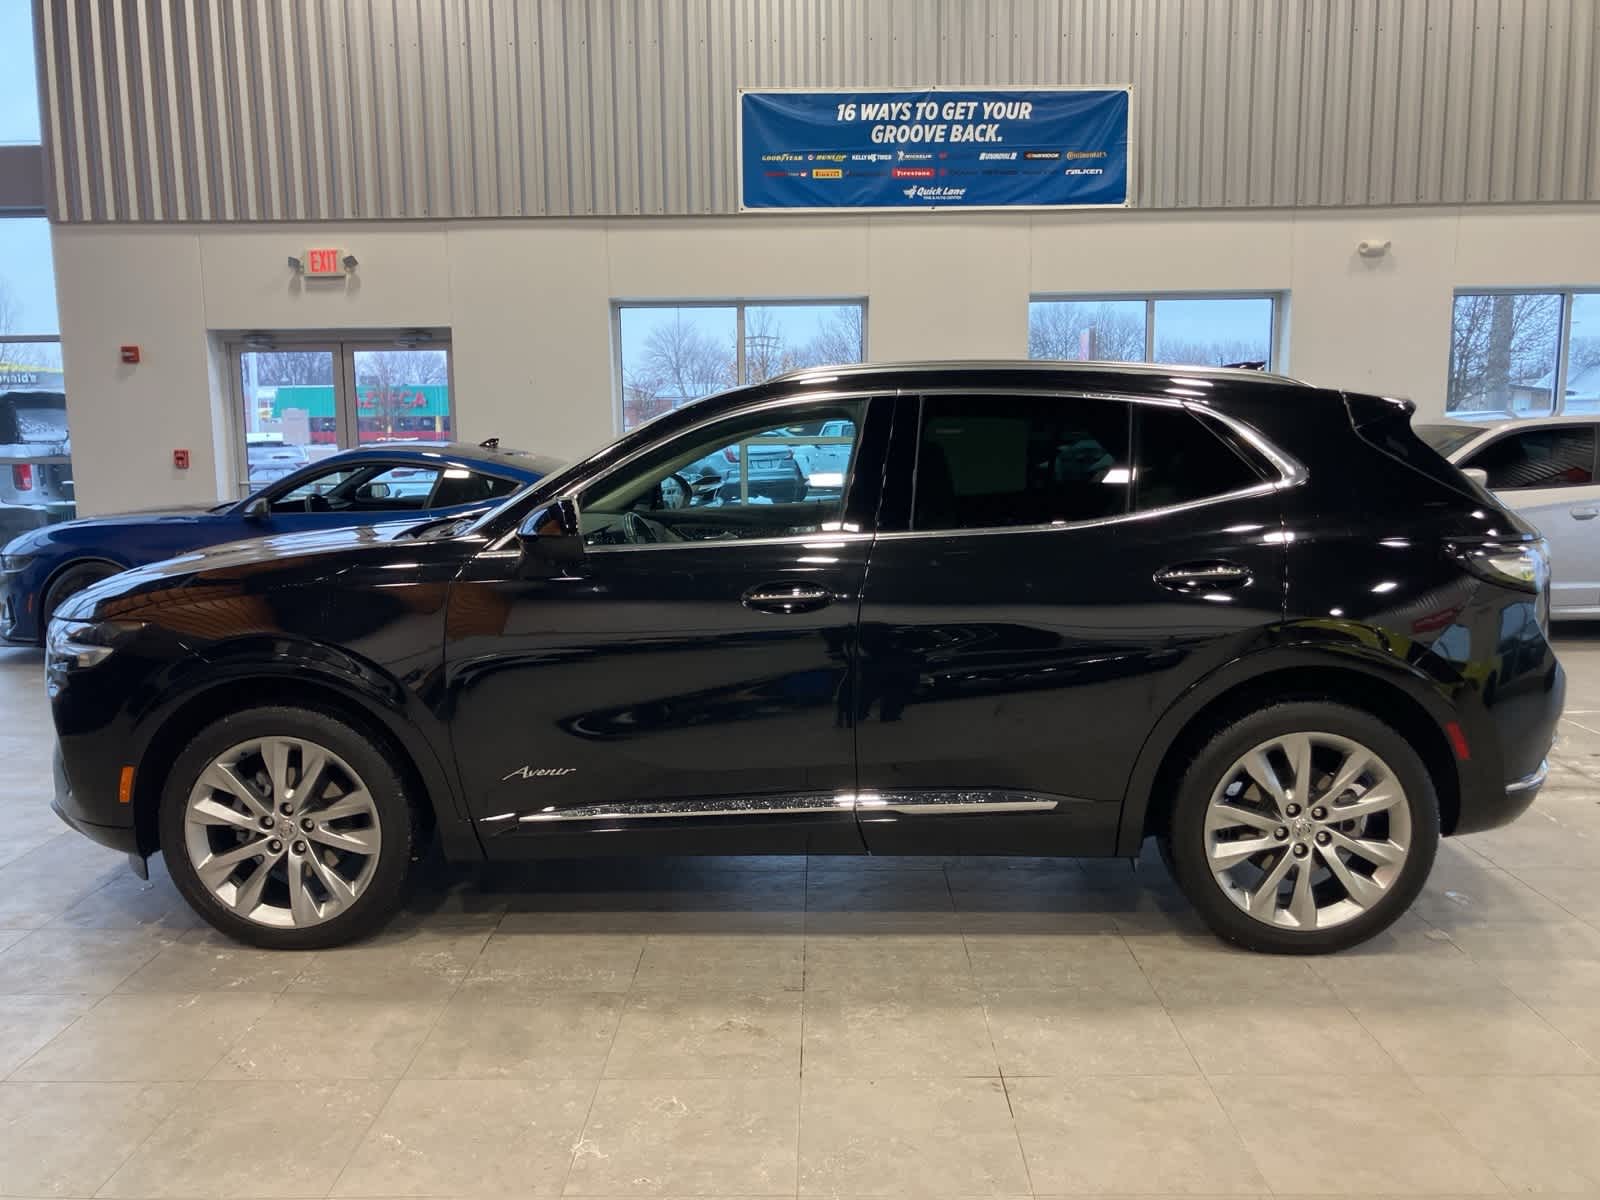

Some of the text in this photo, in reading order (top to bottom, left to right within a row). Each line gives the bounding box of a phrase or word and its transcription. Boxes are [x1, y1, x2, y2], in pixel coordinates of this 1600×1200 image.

[837, 101, 1033, 121] 16 WAYS TO GET YOUR
[871, 124, 1003, 143] GROOVE BACK.
[917, 186, 967, 197] Quick Lane
[309, 249, 337, 273] EXIT
